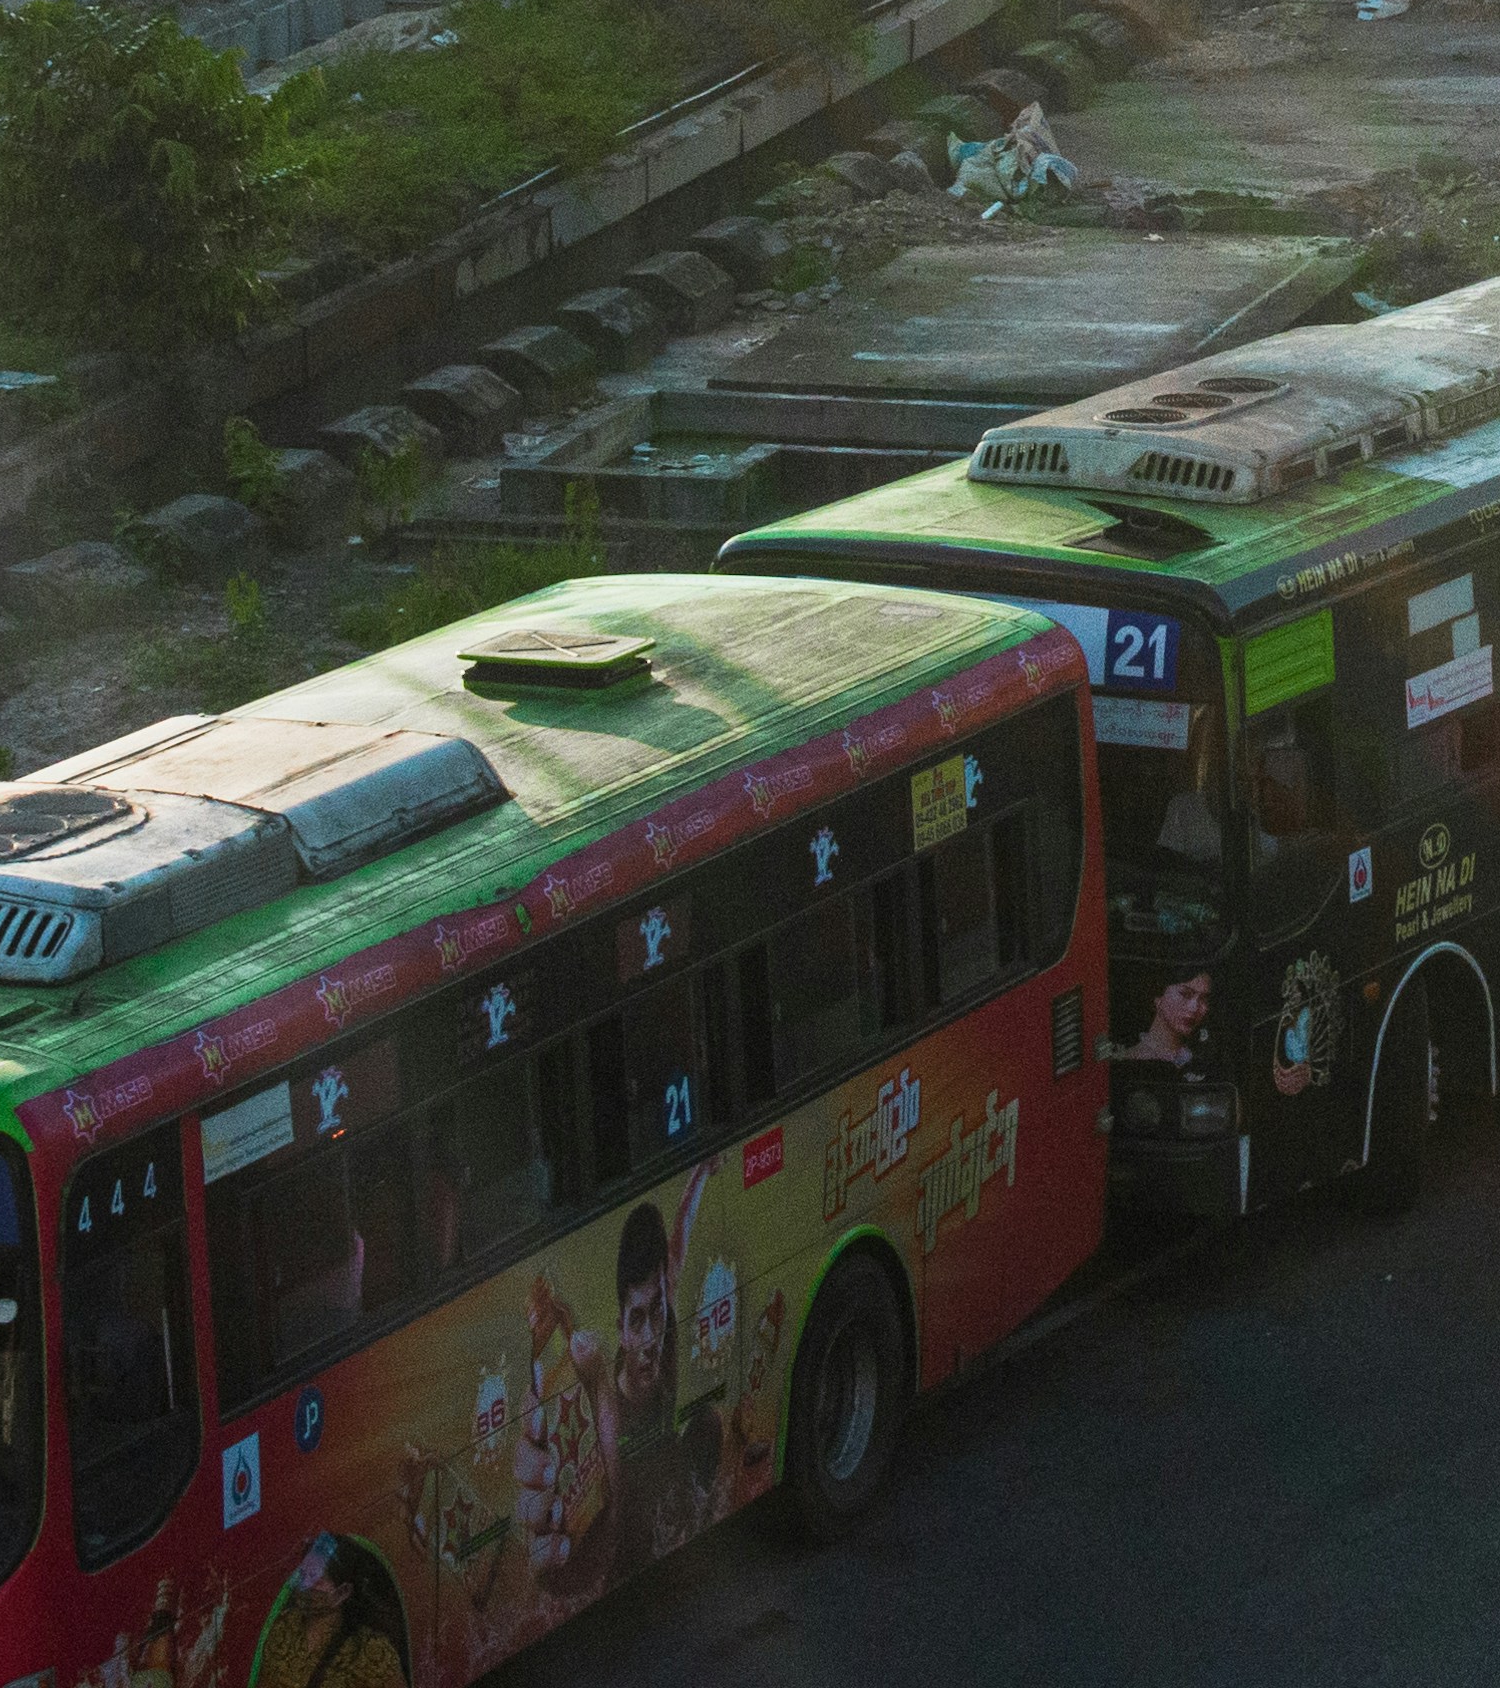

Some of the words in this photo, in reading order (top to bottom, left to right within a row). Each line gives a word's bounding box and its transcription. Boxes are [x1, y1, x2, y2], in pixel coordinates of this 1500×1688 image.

[1112, 623, 1168, 680] 21
[1395, 873, 1433, 918] HEIN
[1435, 862, 1457, 899] NA
[1459, 851, 1477, 888] DI
[665, 1075, 692, 1137] 21
[77, 1195, 93, 1233] 4
[110, 1178, 126, 1216] 4
[142, 1161, 158, 1198] 4
[699, 1299, 732, 1340] B12
[477, 1398, 505, 1435] B6
